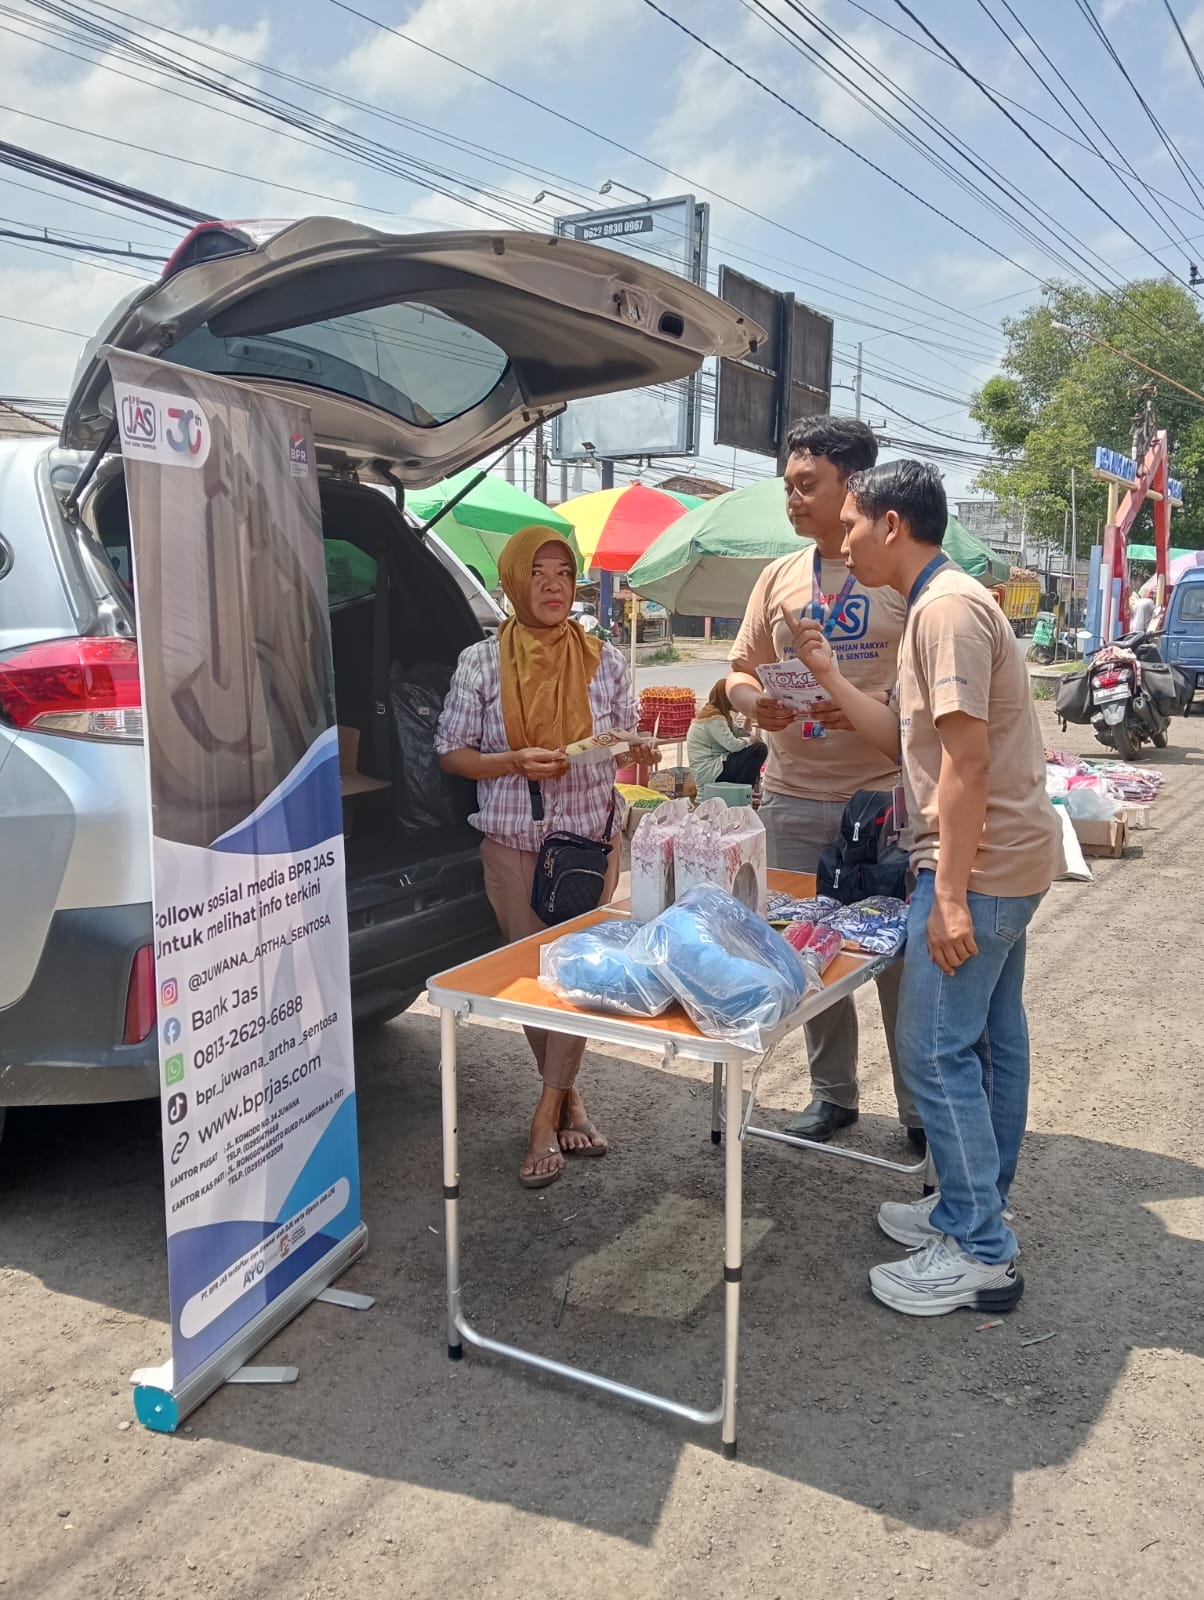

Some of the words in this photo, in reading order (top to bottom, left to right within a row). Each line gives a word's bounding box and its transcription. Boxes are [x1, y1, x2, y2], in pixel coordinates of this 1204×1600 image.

[603, 222, 623, 236] 9830
[624, 220, 644, 232] 0967
[127, 406, 153, 437] JAS
[290, 448, 306, 461] BPR
[846, 651, 880, 661] SENTOSA
[859, 641, 889, 651] RAKYAT
[208, 883, 243, 913] sosial
[247, 869, 285, 898] media
[288, 863, 312, 882] BPR
[313, 851, 335, 872] JAS
[207, 910, 257, 941] melihat
[259, 898, 283, 919] info
[285, 878, 321, 908] terkini
[188, 914, 331, 992] @JUWANA_ARTHA_SENTOSA
[191, 996, 229, 1032] Bank
[231, 985, 258, 1009] Jas
[193, 995, 303, 1069] 0813-2629-6688
[198, 1054, 322, 1144] www.bprjas.com
[169, 1165, 199, 1189] KANTOR
[199, 1152, 219, 1172] PUSAT
[234, 1123, 261, 1144] KOMODO
[171, 1190, 200, 1214] KANTOR
[200, 1181, 214, 1195] KAS
